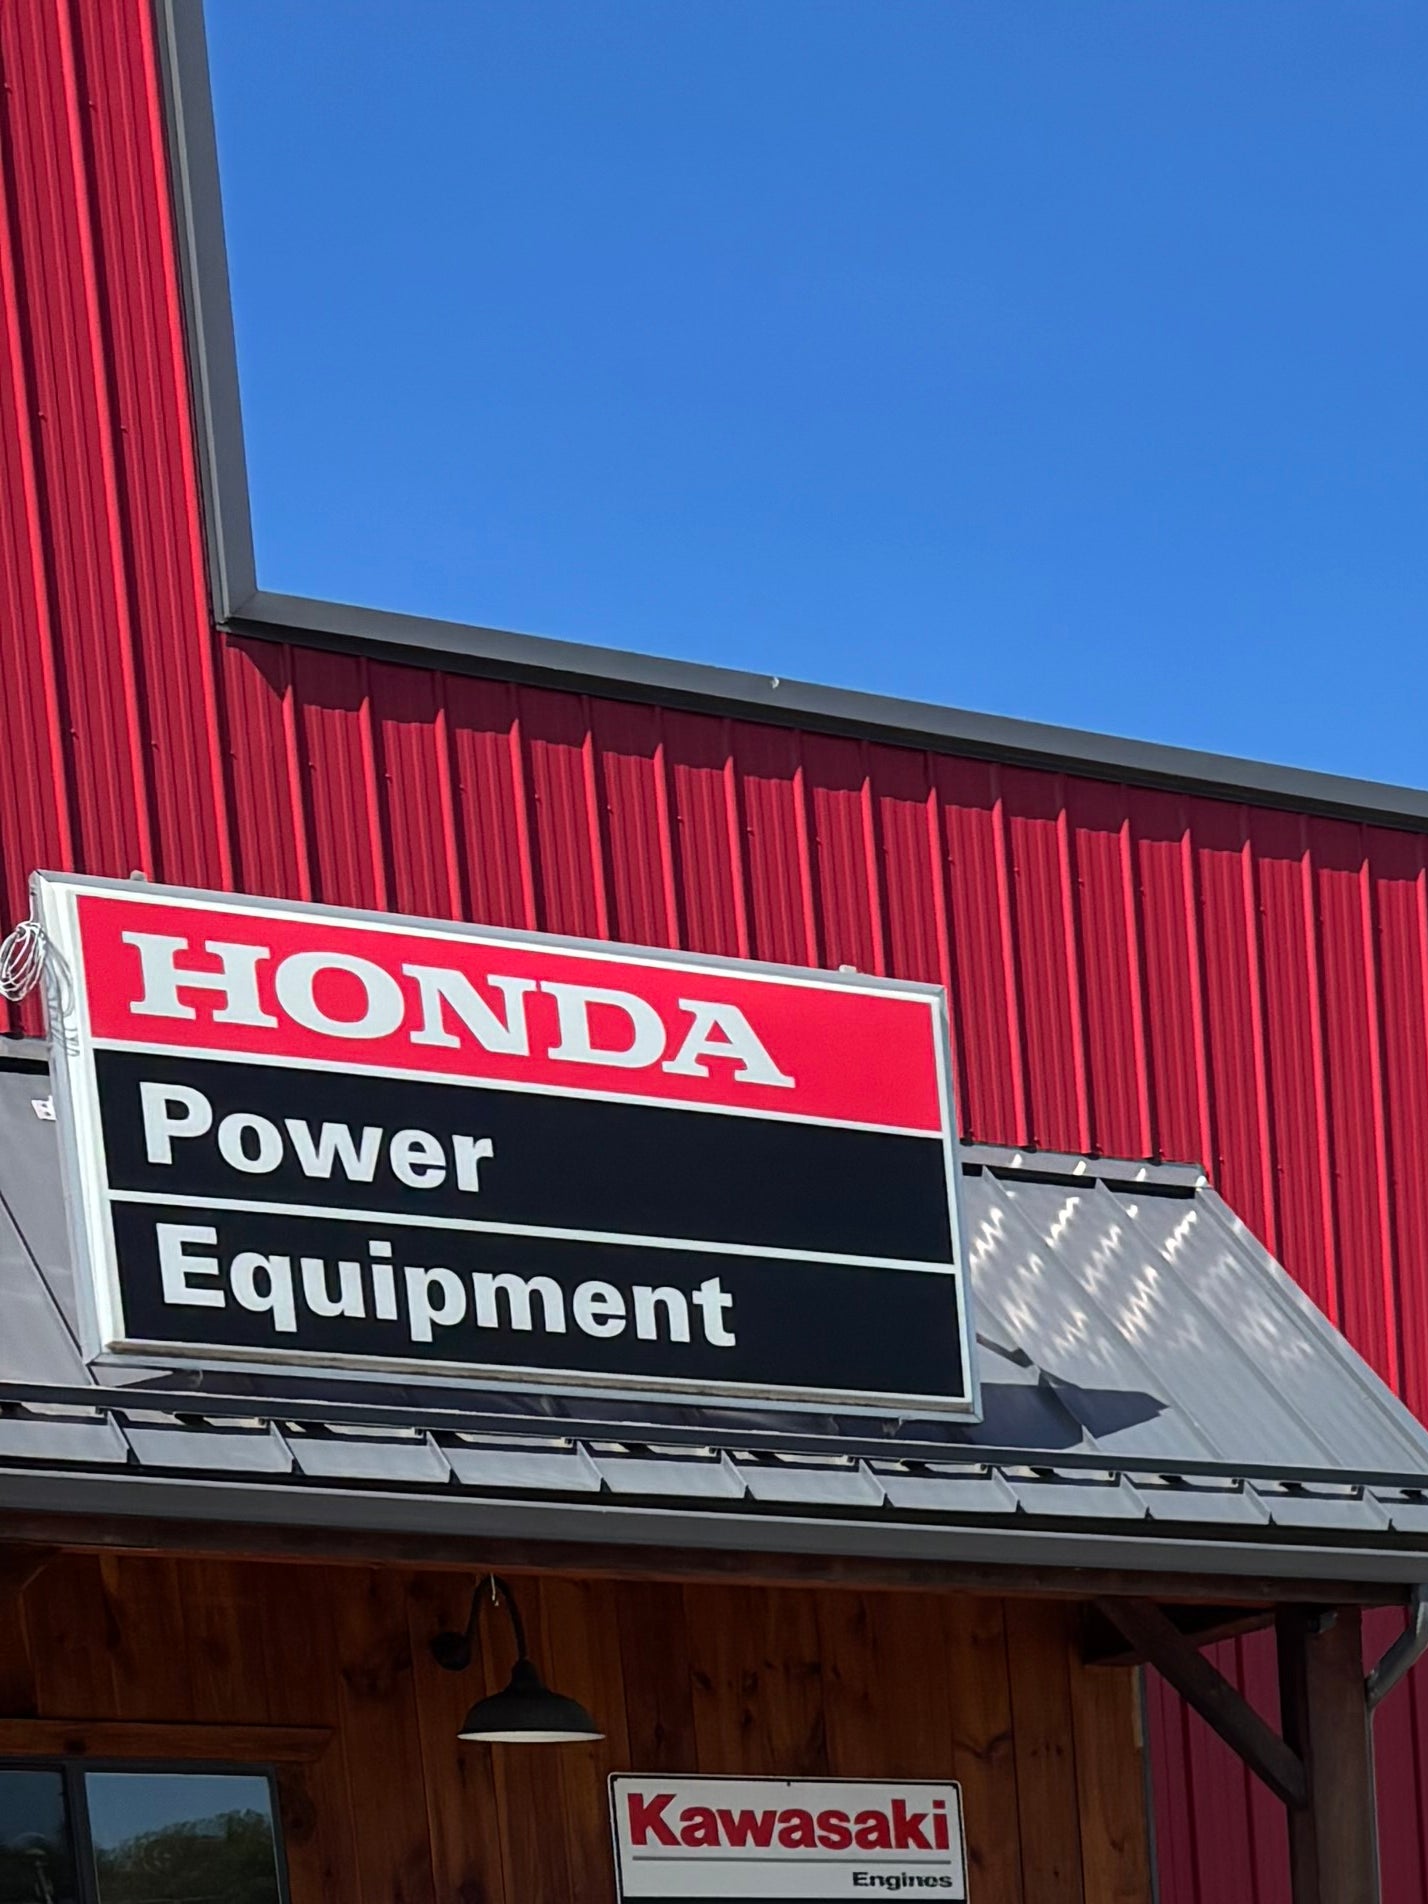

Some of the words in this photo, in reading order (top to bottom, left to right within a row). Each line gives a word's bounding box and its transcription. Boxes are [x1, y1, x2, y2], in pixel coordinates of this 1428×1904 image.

[121, 930, 795, 1089] HONDA
[139, 1082, 495, 1193] Power
[156, 1222, 737, 1348] Equipment
[627, 1793, 950, 1850] Kawasaki
[852, 1872, 952, 1890] Engines
